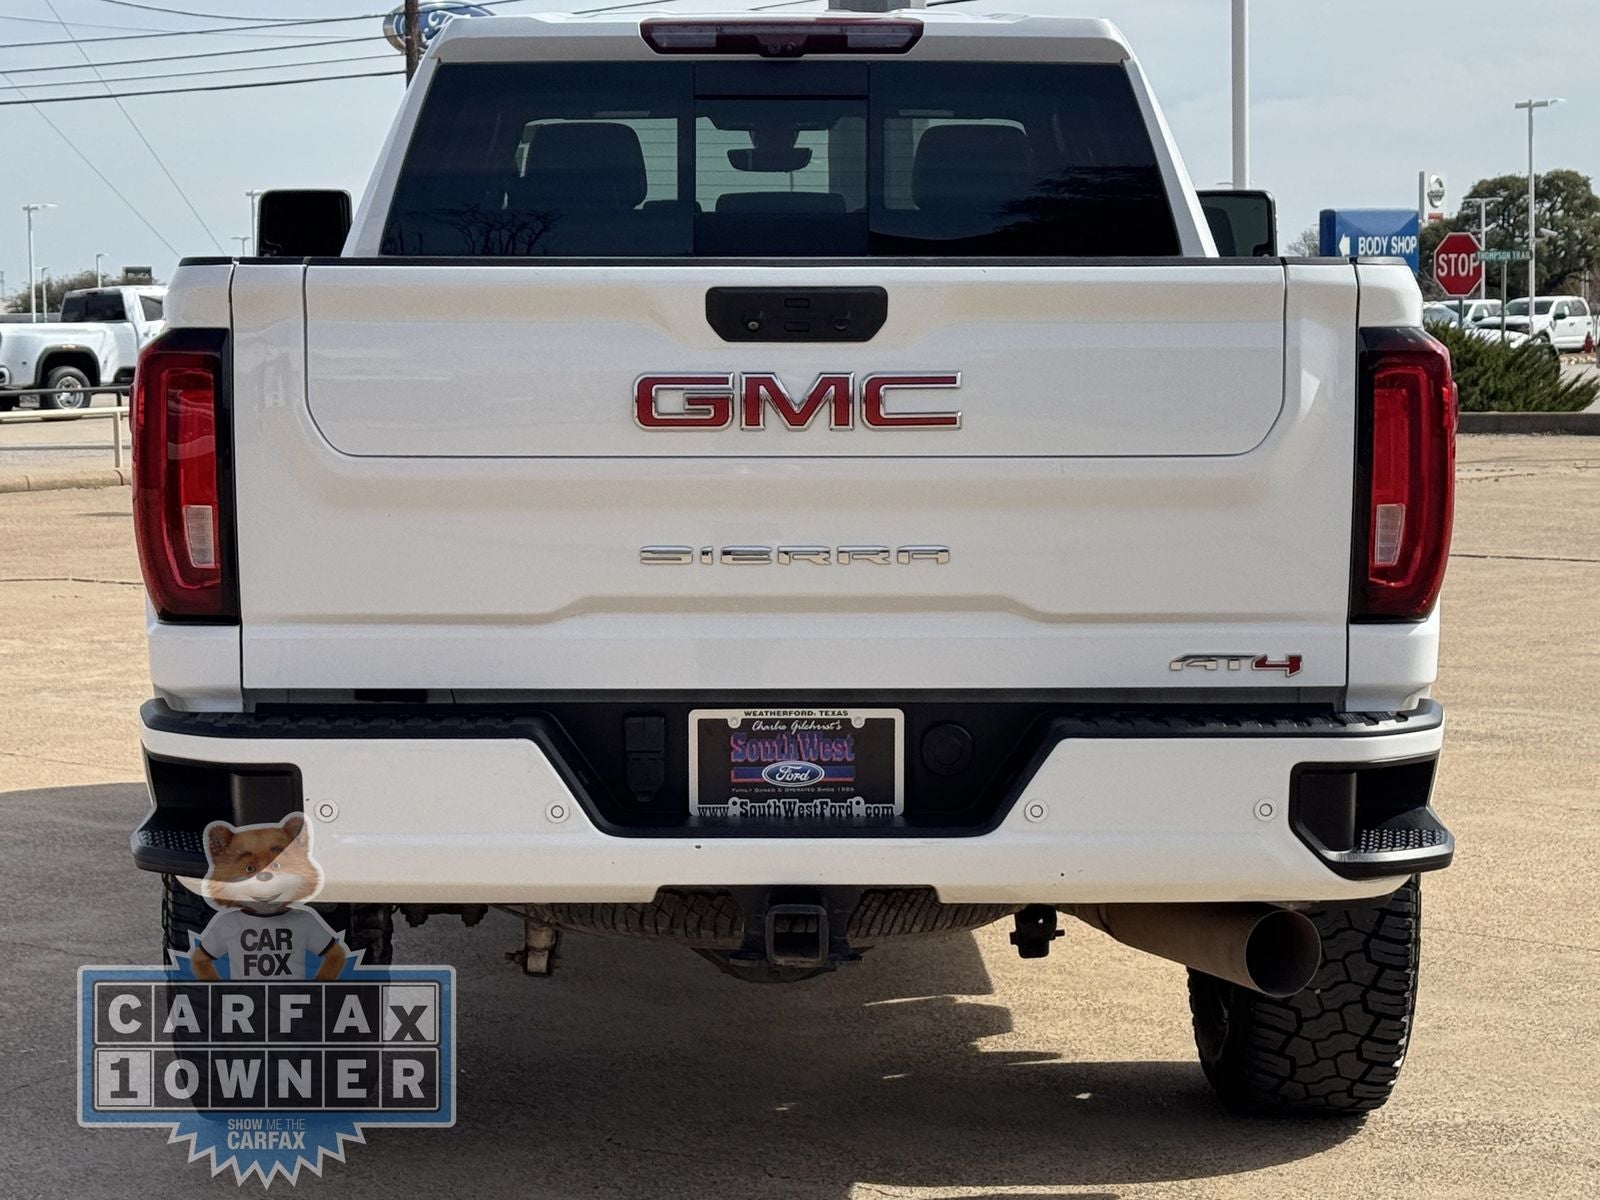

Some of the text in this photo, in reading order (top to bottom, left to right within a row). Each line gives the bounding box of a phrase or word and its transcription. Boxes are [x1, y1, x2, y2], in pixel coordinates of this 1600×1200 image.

[1358, 236, 1417, 255] BODY SHOP
[1477, 250, 1531, 260] THOMPSON TRAIL
[1438, 253, 1479, 277] STOP
[633, 371, 962, 431] GMC
[640, 545, 950, 565] SIERRA
[1169, 652, 1303, 678] AT4
[752, 720, 787, 731] Charlie
[775, 766, 810, 782] Ford
